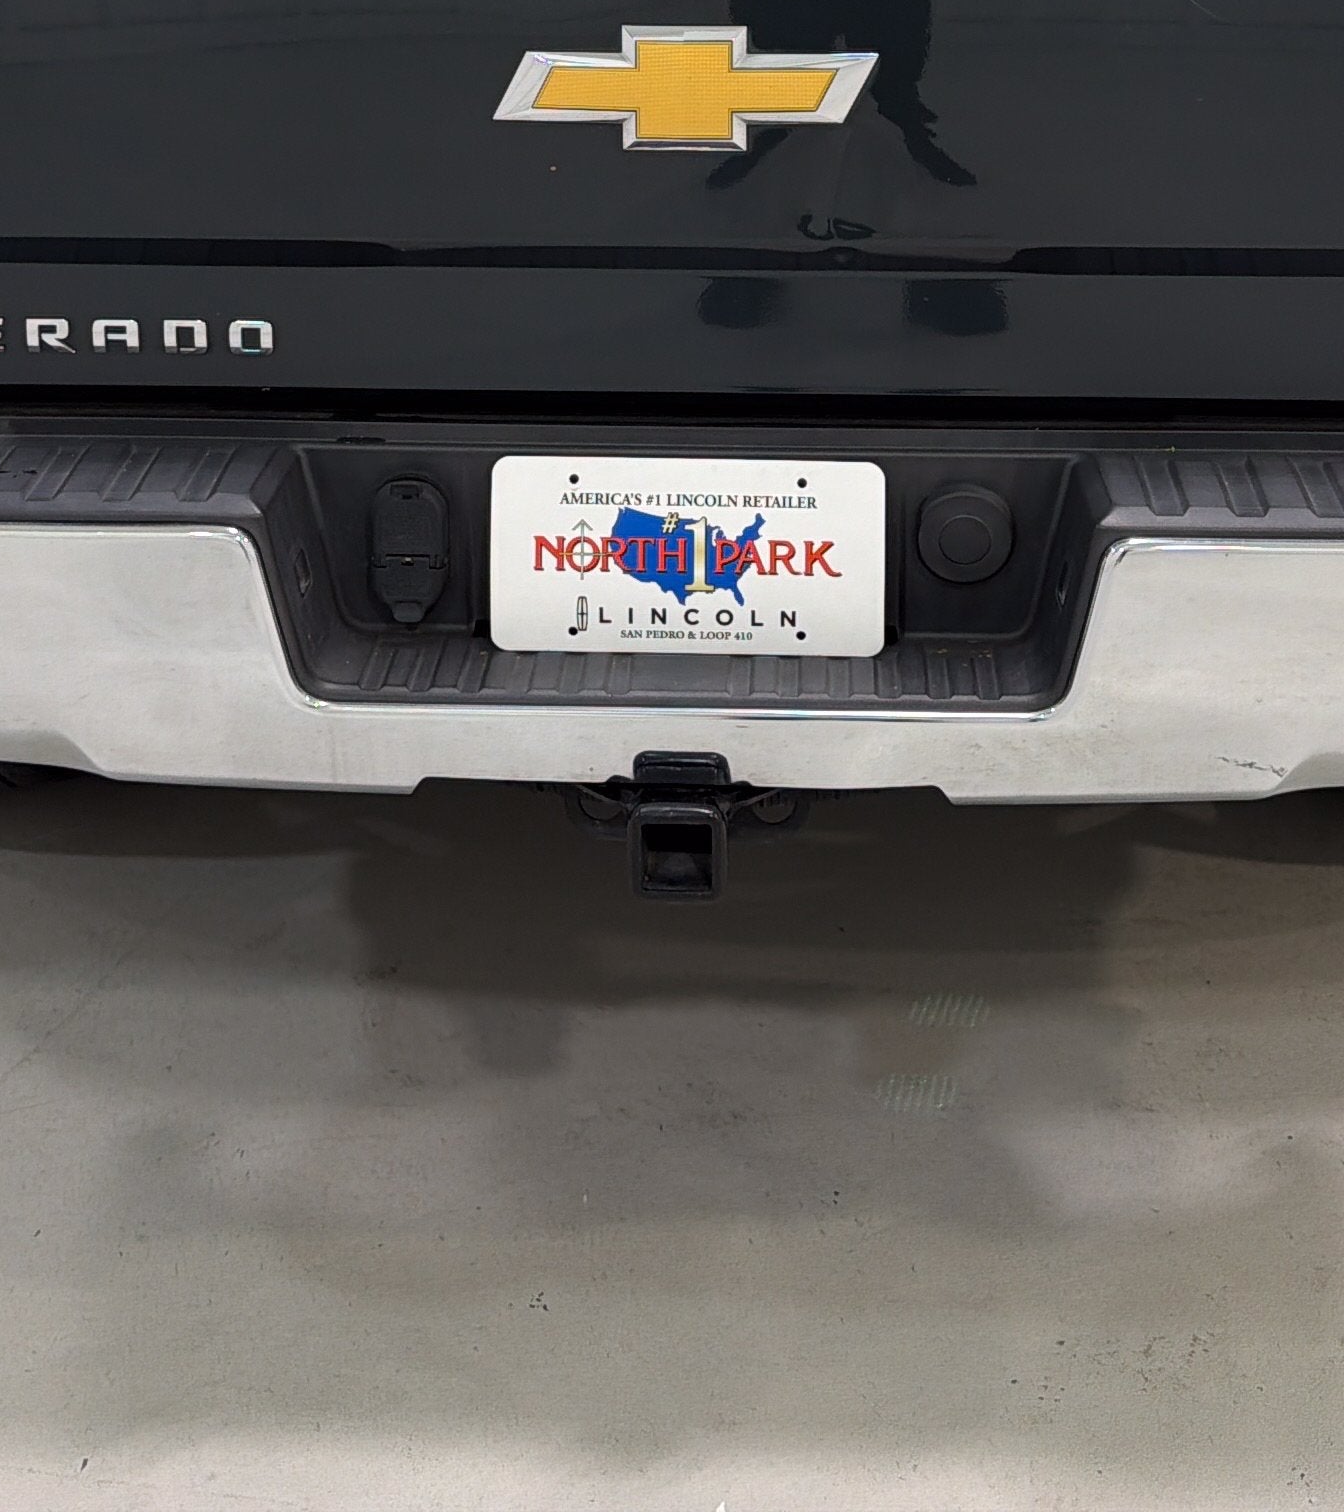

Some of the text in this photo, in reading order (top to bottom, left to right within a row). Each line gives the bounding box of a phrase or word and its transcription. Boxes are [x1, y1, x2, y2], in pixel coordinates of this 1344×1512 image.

[559, 492, 817, 509] AMERICA'S #1 LINCOLN RETAILER
[533, 535, 843, 578] NORTH PARK
[598, 606, 797, 628] LINCOLN
[620, 630, 753, 641] SAN PEDRO & LOOP 410
